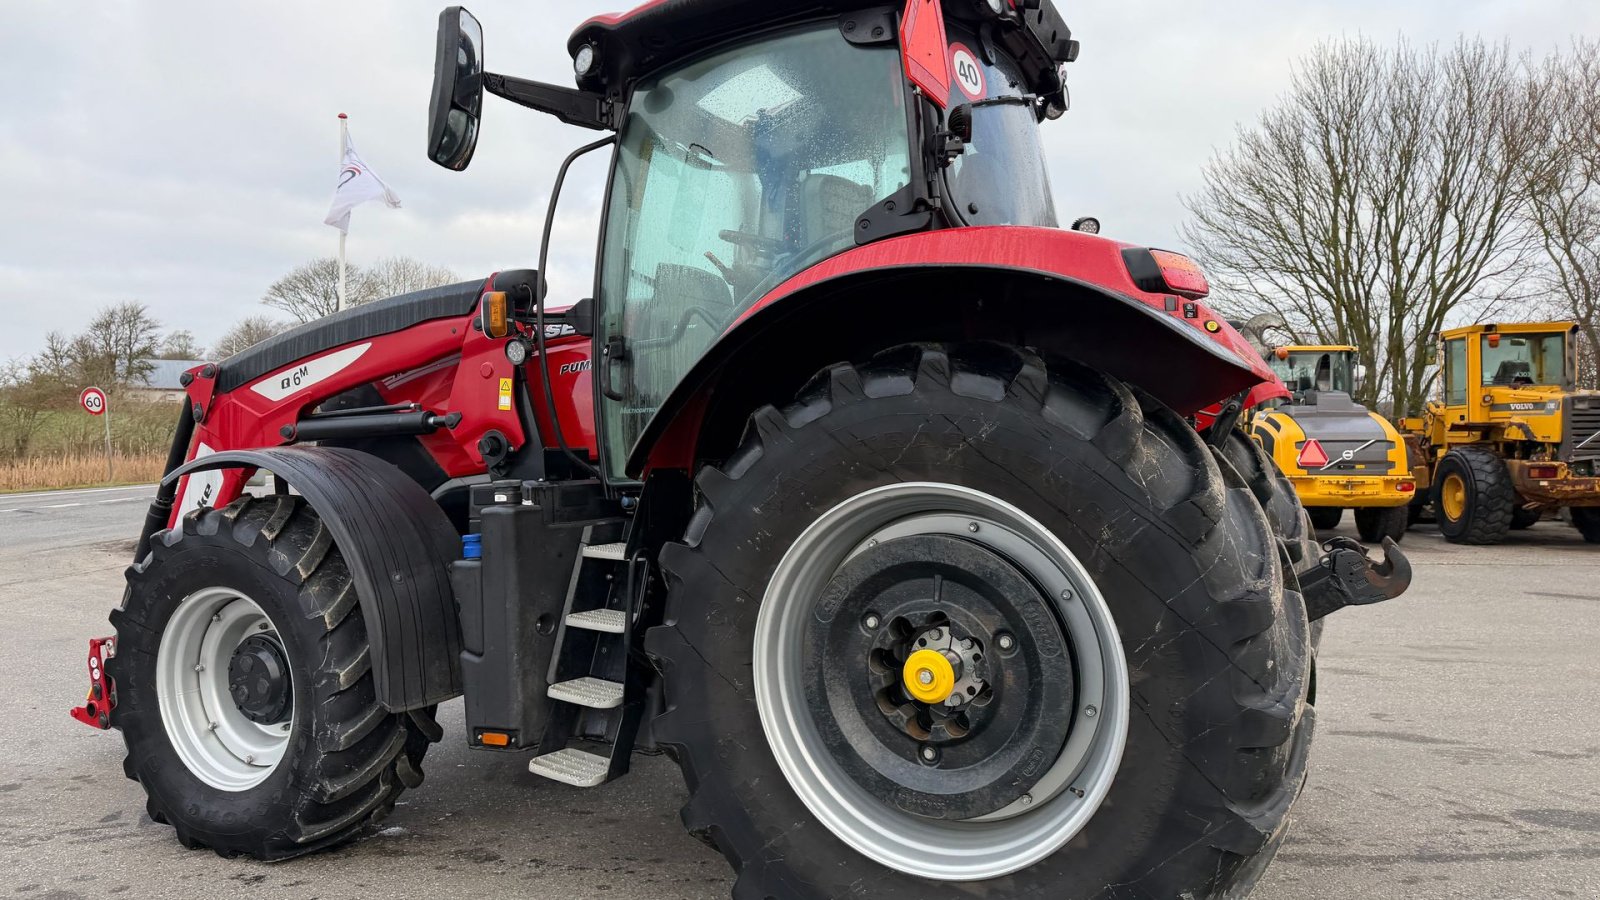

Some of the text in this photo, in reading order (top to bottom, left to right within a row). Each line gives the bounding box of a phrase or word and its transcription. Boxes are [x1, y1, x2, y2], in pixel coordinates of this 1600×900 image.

[959, 60, 978, 86] 40
[560, 359, 592, 375] PUM
[86, 396, 101, 408] 60
[1510, 402, 1534, 411] VOLVO
